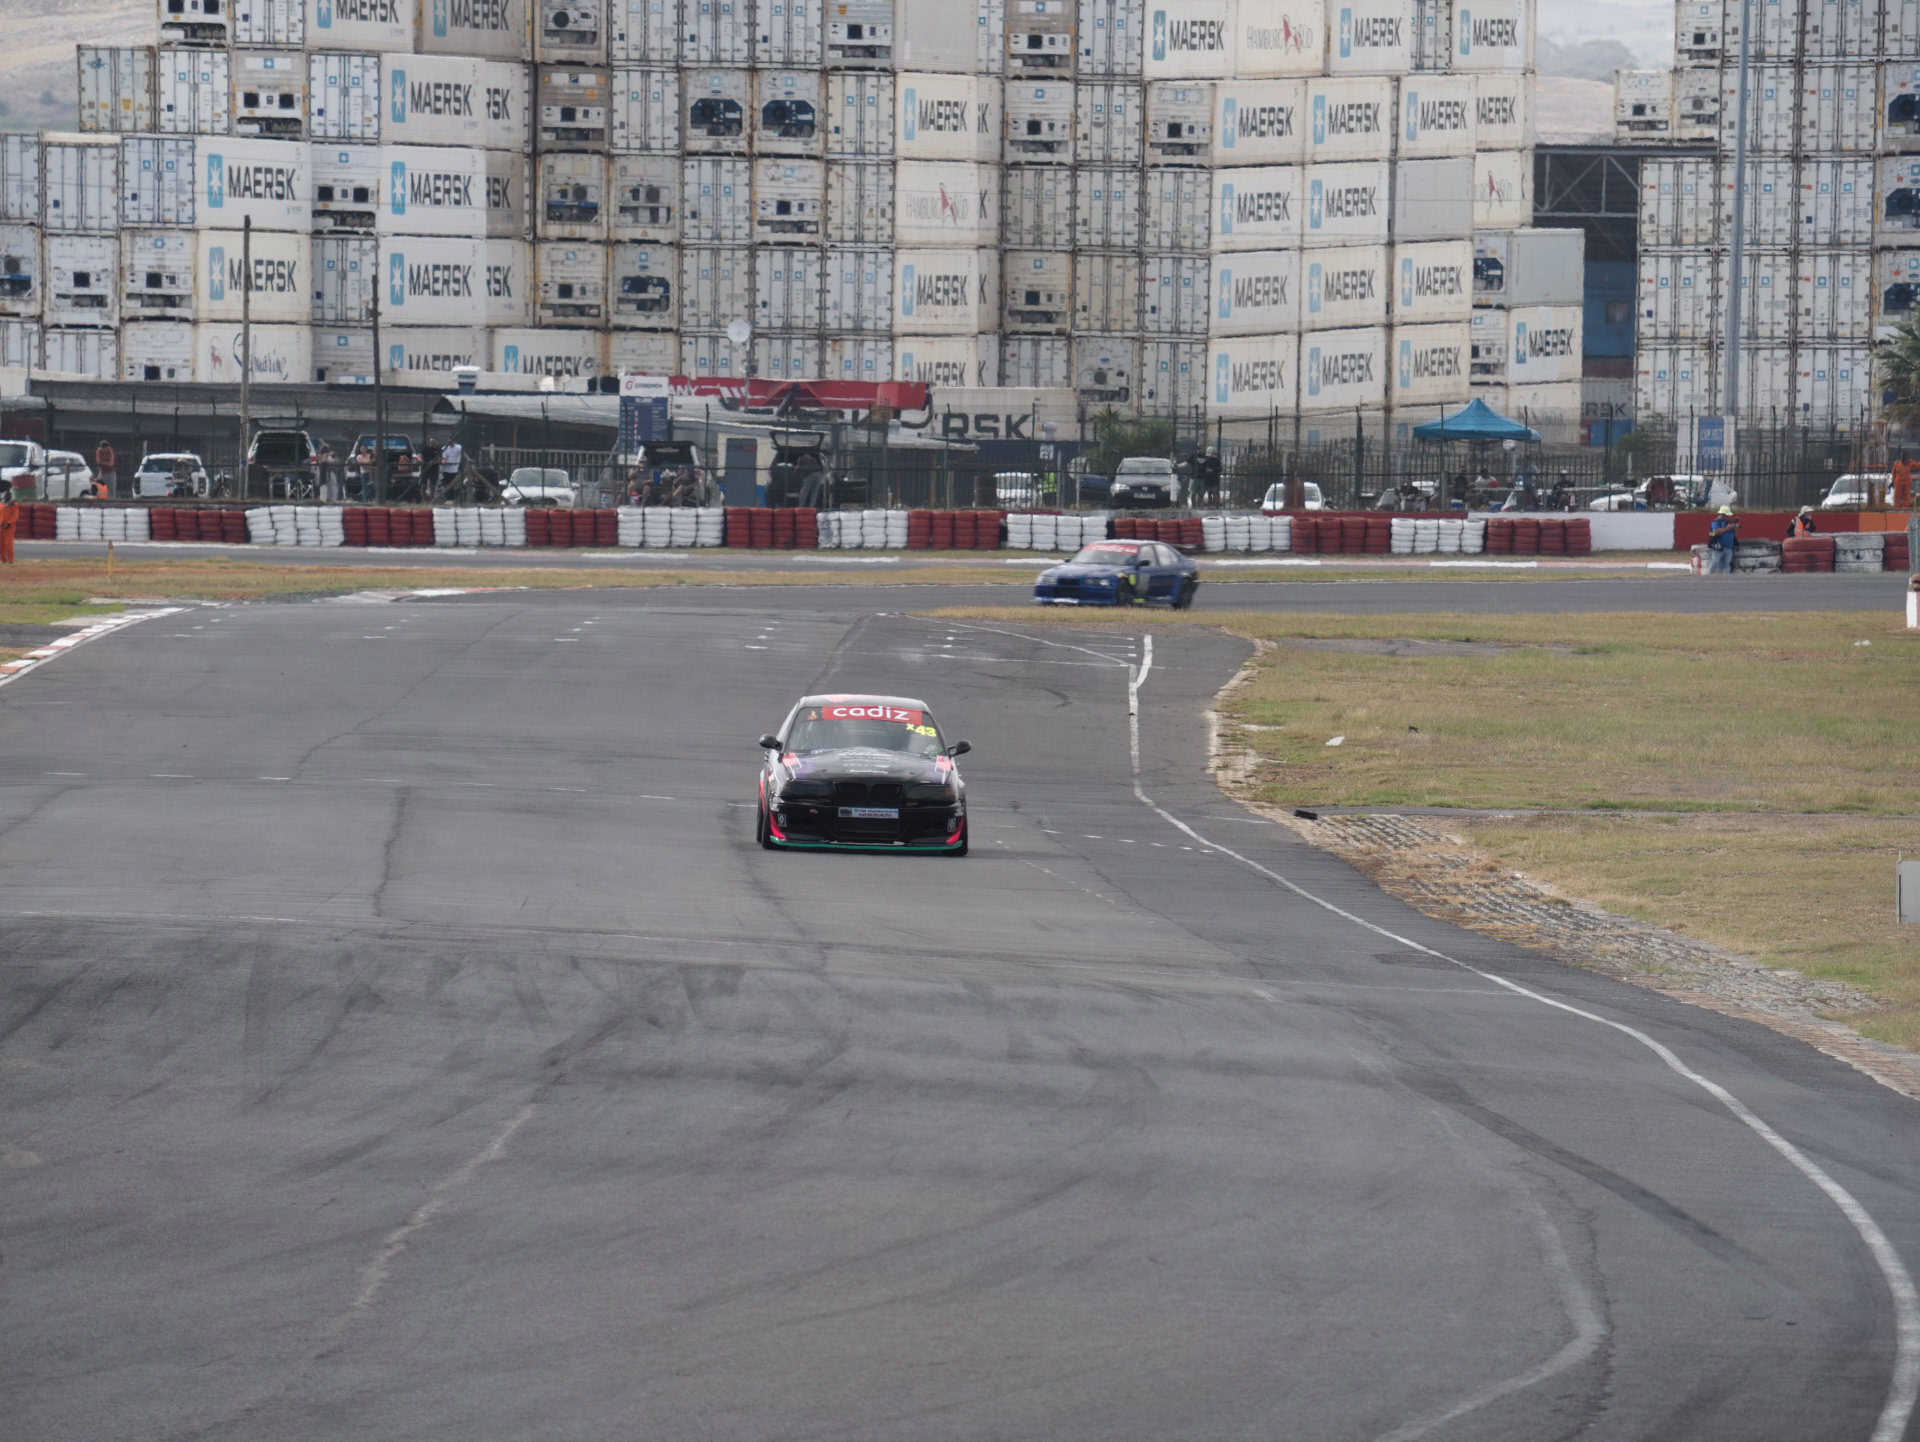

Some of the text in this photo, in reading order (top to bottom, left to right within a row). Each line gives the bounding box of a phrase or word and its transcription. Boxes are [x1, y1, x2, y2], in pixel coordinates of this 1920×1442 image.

[336, 0, 398, 23] MAERSK
[450, 0, 509, 30] MAERSK
[1168, 20, 1224, 51] MAERSK
[1355, 17, 1402, 48] MAERSK
[1473, 18, 1517, 47] MAERSK
[411, 81, 472, 116] MAERSK
[918, 100, 967, 132] MAERSK
[1239, 106, 1293, 138] MAERSK
[1329, 102, 1380, 134] MAERSK
[1420, 100, 1467, 131] MAERSK
[228, 166, 295, 200] MAERSK
[410, 173, 472, 207] MAERSK
[1237, 191, 1290, 222] MAERSK
[1325, 186, 1376, 218] MAERSK
[408, 264, 472, 298] MAERSK
[917, 274, 967, 306] MAERSK
[1235, 275, 1288, 308] MAERSK
[1324, 269, 1375, 302] MAERSK
[1415, 266, 1462, 297] MAERSK
[1530, 328, 1574, 358] MAERSK
[1232, 360, 1284, 392] MAERSK
[1323, 353, 1373, 385] MAERSK
[1413, 347, 1460, 377] MAERSK
[833, 705, 910, 721] cadiz
